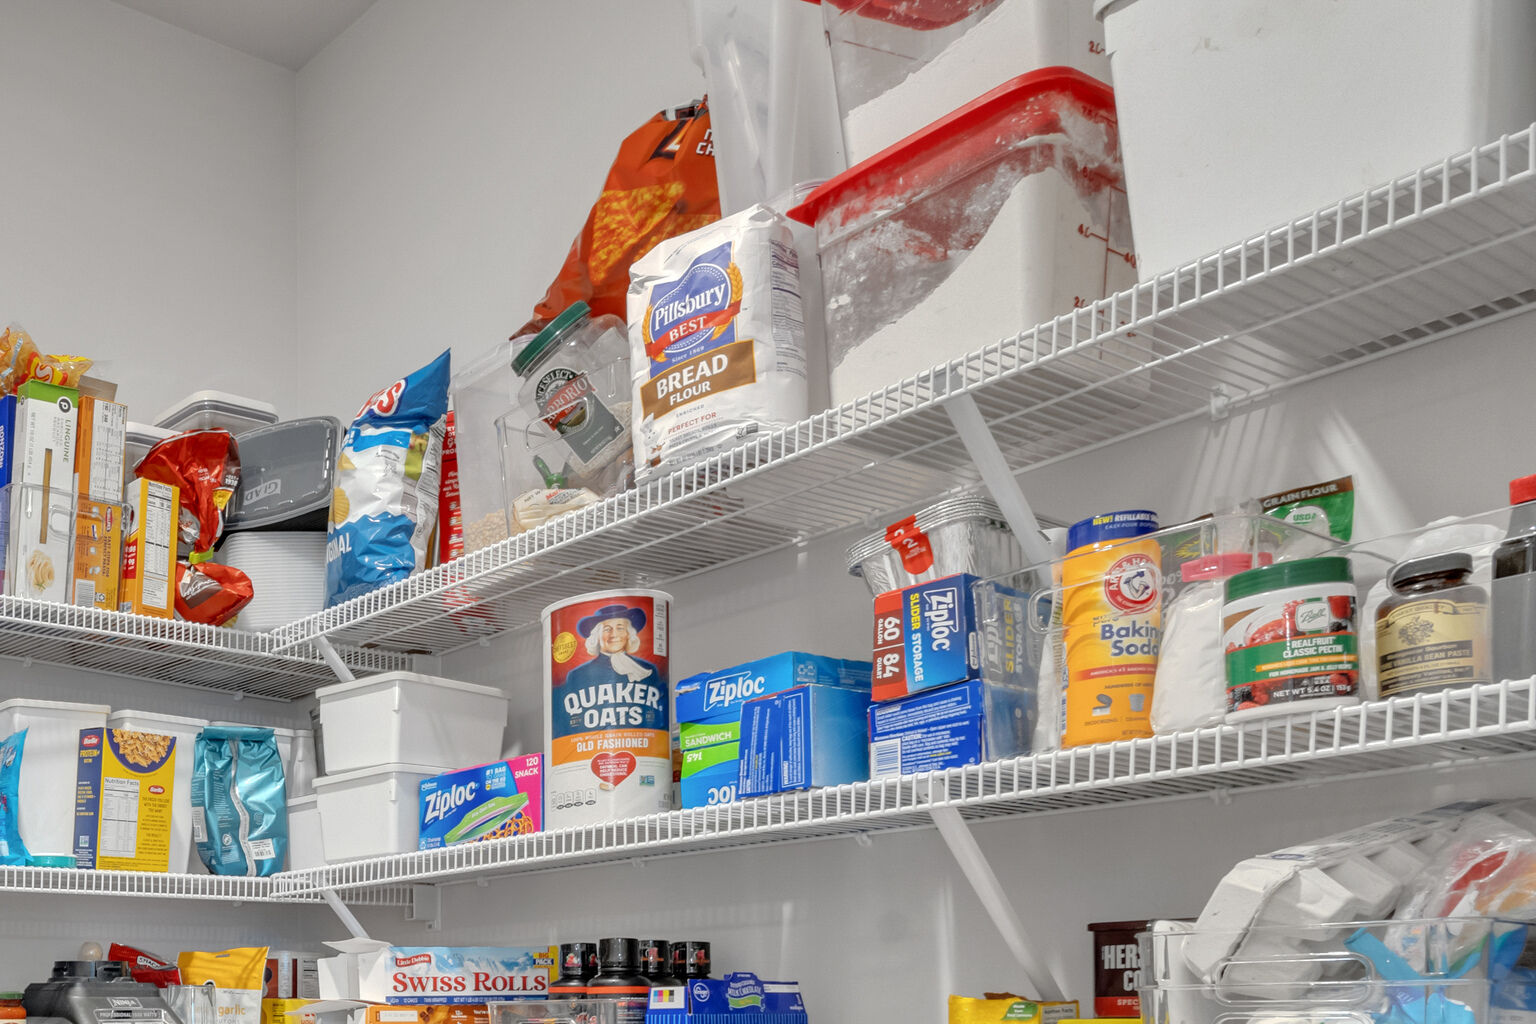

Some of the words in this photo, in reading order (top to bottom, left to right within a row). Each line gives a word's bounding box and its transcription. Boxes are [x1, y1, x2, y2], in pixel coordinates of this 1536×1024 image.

[653, 282, 727, 331] Pillsbury
[668, 316, 708, 342] BEST
[656, 353, 729, 400] BREAD
[669, 381, 711, 406] FLOUR
[667, 417, 699, 434] PERFECT
[700, 411, 718, 426] FOR
[63, 419, 72, 463] LINGUINE
[245, 481, 278, 503] GLAD
[1264, 492, 1298, 509] GRAIN
[1300, 483, 1339, 500] FLOUR
[1093, 515, 1114, 526] NEW!
[909, 592, 922, 630] SLIDER
[925, 588, 955, 652] Ziploc
[1299, 606, 1327, 624] Ball
[877, 618, 885, 645] GALLON
[883, 616, 900, 641] 60
[1004, 599, 1015, 673] SLIDER
[1282, 645, 1317, 658] CLASSIC
[1291, 636, 1335, 648] REALFRUIT
[875, 656, 884, 679] QUART
[882, 652, 900, 679] 84
[911, 632, 925, 683] STORAGE
[564, 682, 662, 717] QUAKER
[708, 677, 765, 707] Ziploc
[583, 705, 643, 728] OATS
[576, 741, 596, 753] OLD
[597, 736, 649, 751] FASHIONED
[684, 730, 733, 748] SANDWICH
[526, 757, 540, 768] 120
[686, 752, 703, 762] 145
[104, 778, 124, 787] Nutrition
[514, 767, 540, 779] SNACK
[424, 780, 477, 823] Ziploc
[397, 956, 413, 967] Little
[413, 954, 432, 964] Debbie
[535, 958, 553, 966] PACK
[392, 971, 466, 994] SWISS
[472, 969, 547, 993] ROLLS
[111, 998, 136, 1008] NINJA
[217, 1005, 246, 1017] garlic
